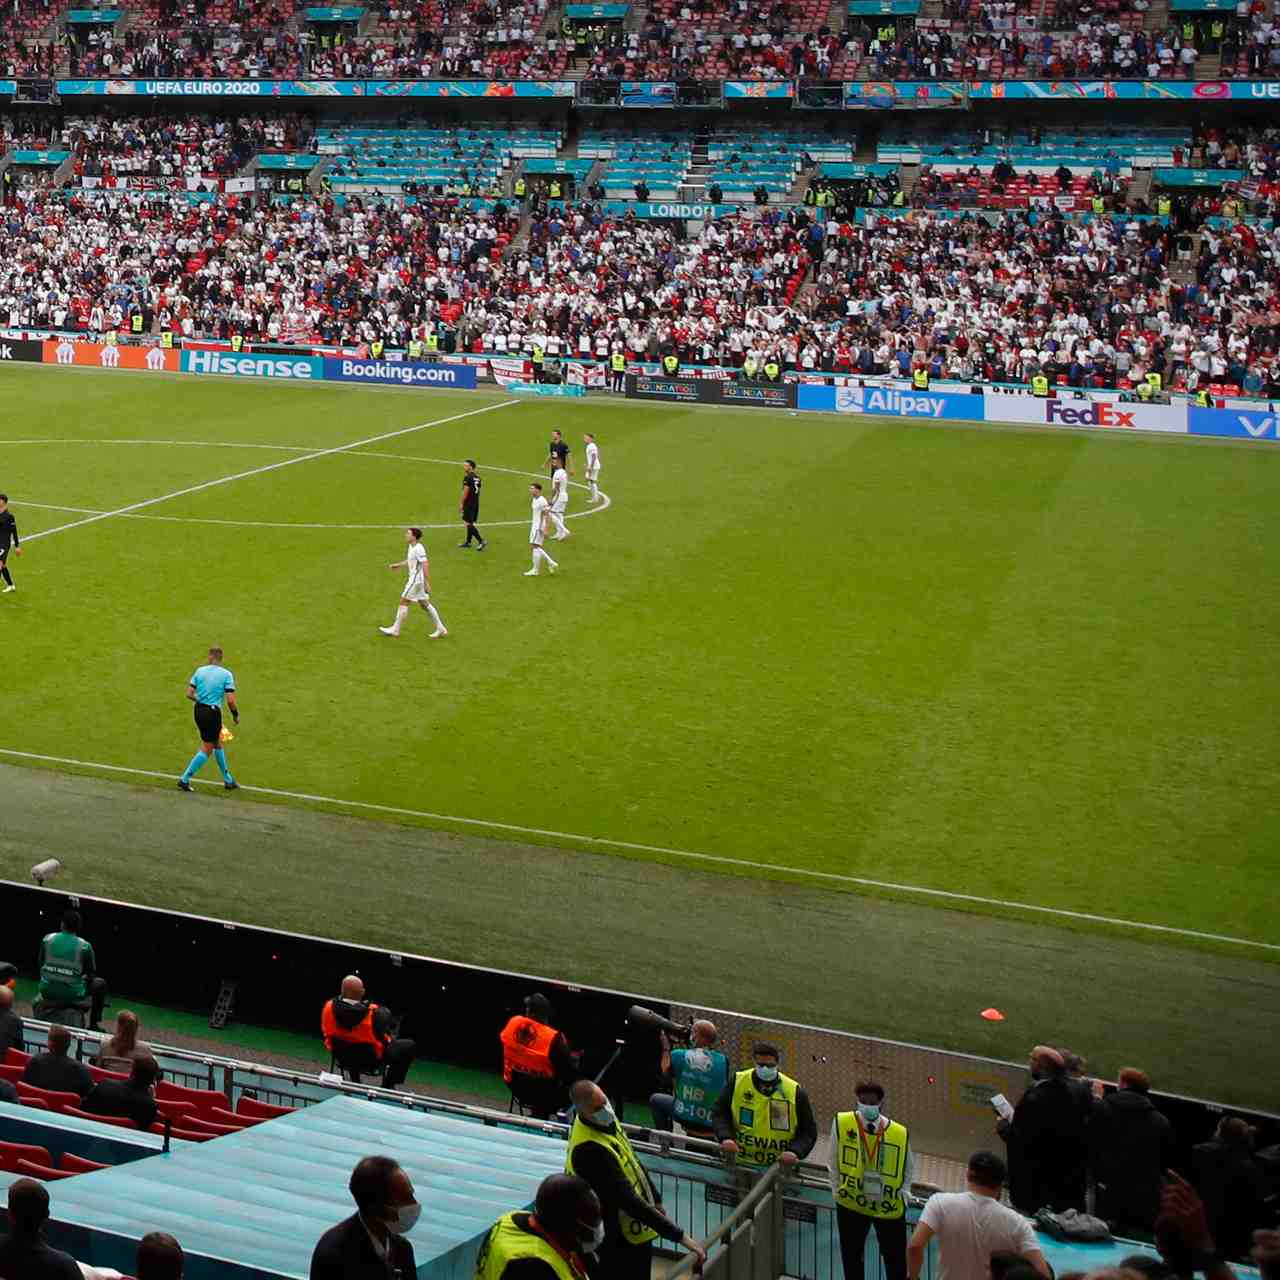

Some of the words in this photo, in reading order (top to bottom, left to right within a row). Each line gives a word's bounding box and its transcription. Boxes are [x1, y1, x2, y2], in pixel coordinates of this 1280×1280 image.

[146, 81, 183, 95] UEFA
[183, 81, 223, 95] EURO
[223, 81, 261, 95] 2020
[188, 350, 312, 378] Hisense
[342, 360, 456, 383] Booking.com
[867, 391, 945, 417] Alipay
[1045, 399, 1137, 428] FedEx
[738, 1131, 792, 1151] TEWAR
